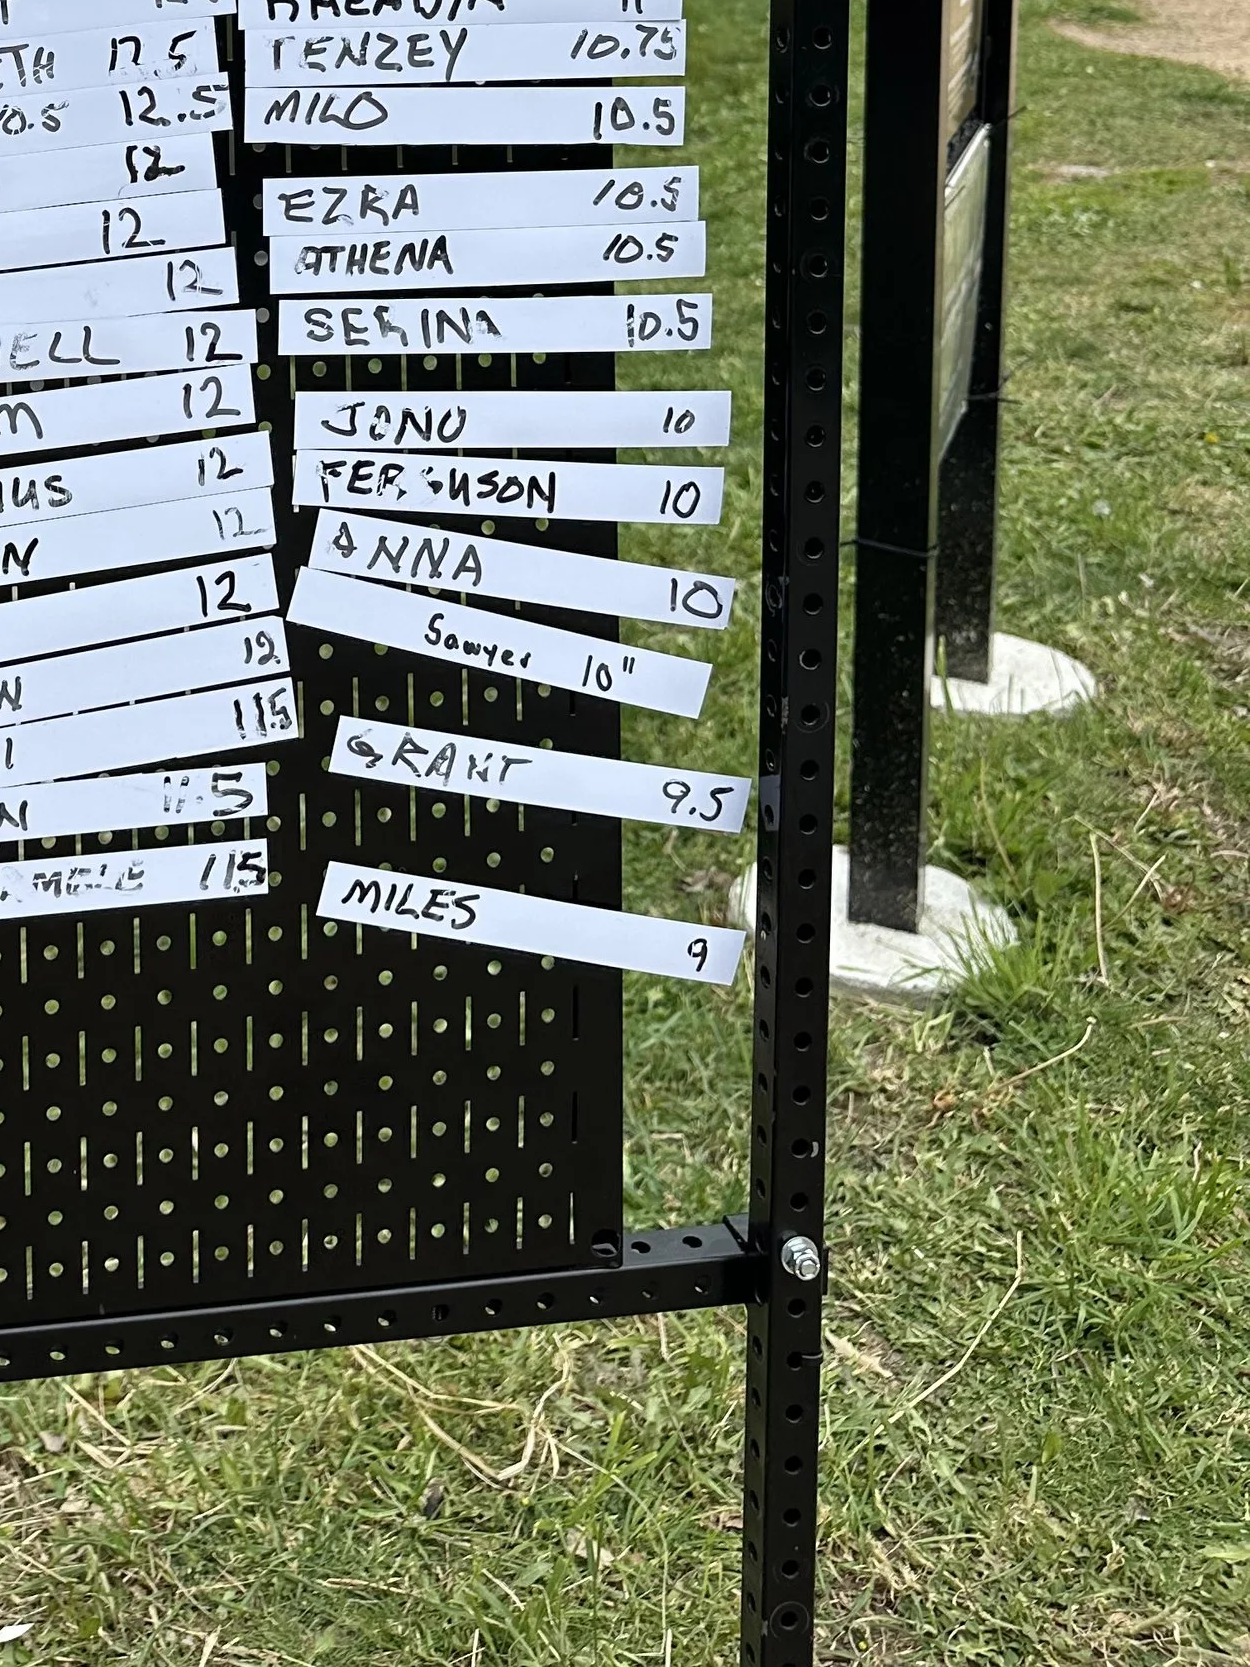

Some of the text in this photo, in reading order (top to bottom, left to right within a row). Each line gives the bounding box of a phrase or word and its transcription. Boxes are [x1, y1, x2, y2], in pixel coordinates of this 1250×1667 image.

[264, 23, 678, 83] TENZEY 10.75
[119, 84, 231, 127] 12.5
[263, 90, 676, 141] MILO 10.5
[125, 144, 186, 184] 12
[277, 176, 683, 227] EZRA 10.5
[101, 207, 167, 255] 12
[294, 231, 679, 275] ATHENA 10.5
[165, 259, 224, 302] 12
[185, 321, 244, 363] 12
[626, 298, 700, 348] 10.5
[182, 375, 243, 420] 12
[320, 399, 696, 446] JONO 10
[197, 445, 245, 487] 12
[659, 479, 701, 516] 10
[212, 506, 268, 540] 12
[195, 569, 252, 617] 12
[332, 520, 724, 619] ANNA 10
[243, 629, 282, 666] 12
[162, 771, 254, 818] 11.5
[345, 730, 735, 822] GRANT 9.5
[341, 879, 709, 972] MILES 9
